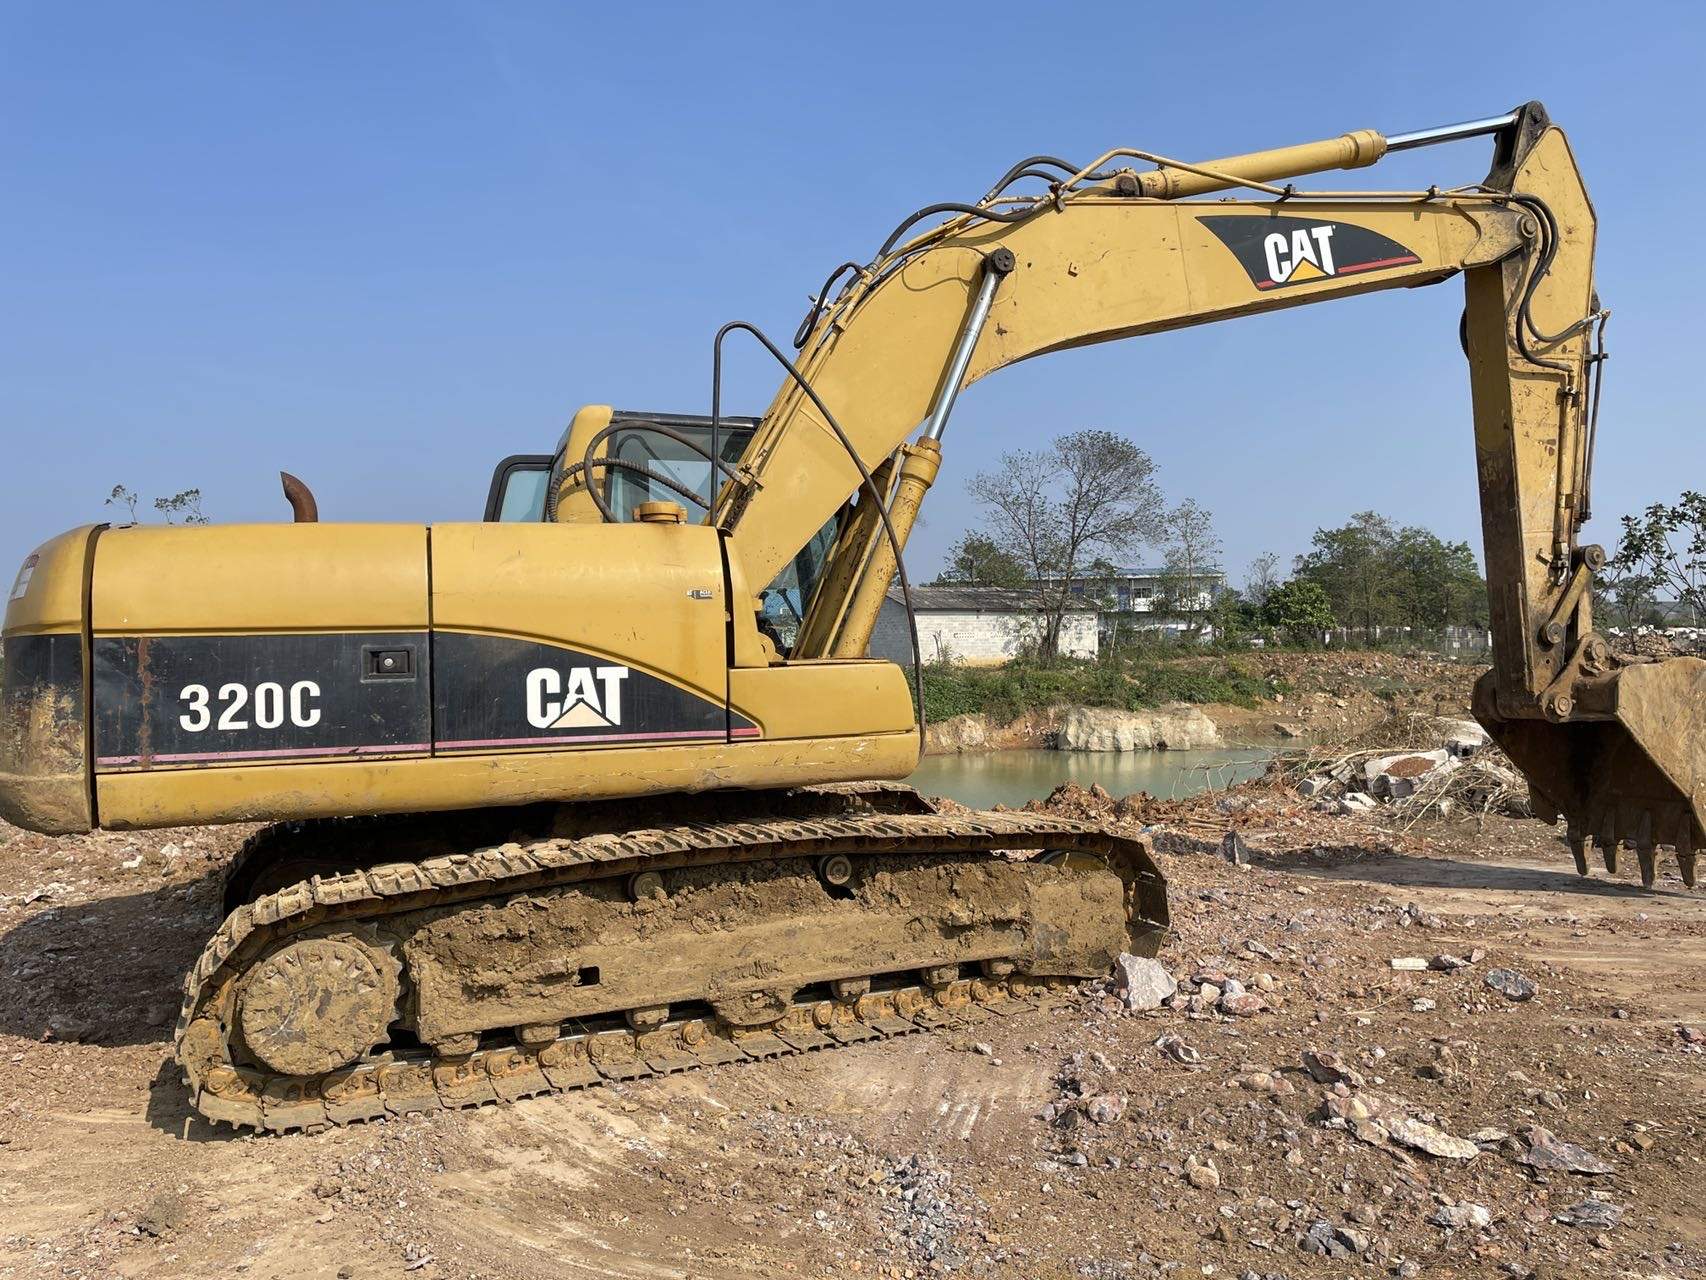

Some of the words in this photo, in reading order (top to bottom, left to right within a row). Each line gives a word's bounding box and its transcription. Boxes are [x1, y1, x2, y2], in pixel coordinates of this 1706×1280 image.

[1264, 225, 1335, 283] CAT
[179, 680, 322, 732] 320C
[526, 666, 629, 729] CAT
